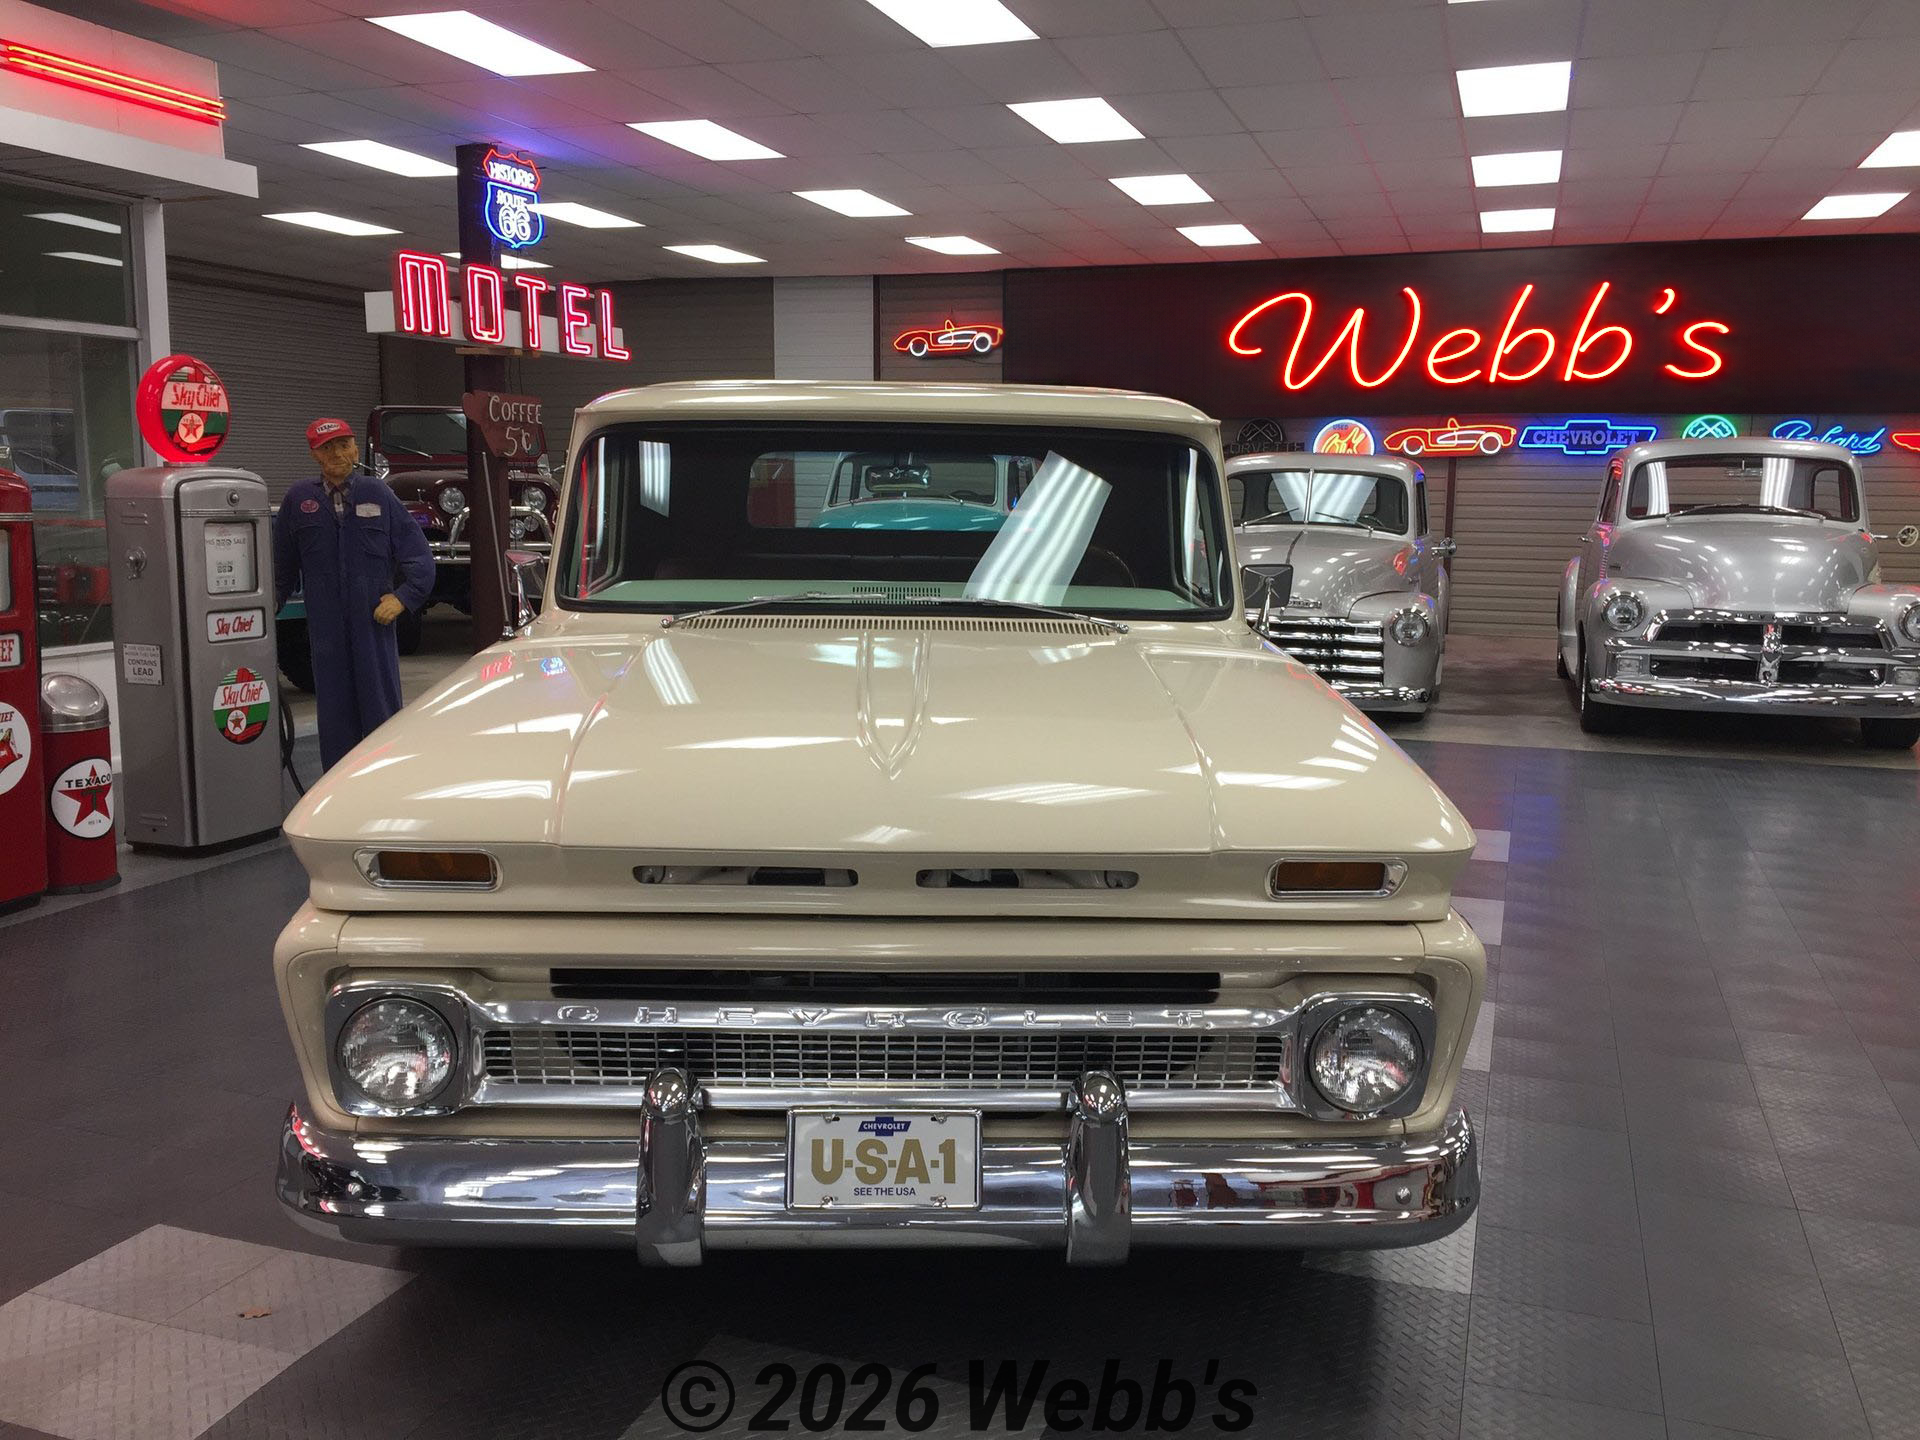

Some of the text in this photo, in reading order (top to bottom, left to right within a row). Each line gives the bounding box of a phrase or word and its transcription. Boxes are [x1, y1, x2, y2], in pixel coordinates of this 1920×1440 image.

[488, 161, 535, 189] HISTORIC
[496, 189, 528, 209] ROUTE
[498, 205, 531, 241] 66
[395, 252, 632, 361] MOTEL
[1228, 281, 1731, 391] Webb's
[171, 383, 223, 409] Sky Chief
[489, 395, 543, 425] COFFEE
[1533, 430, 1640, 446] CHEVROLET
[215, 615, 255, 636] Sky Chief
[132, 667, 154, 676] LEAD
[221, 682, 264, 707] Sky Chief
[65, 773, 111, 788] TEXACO
[556, 1005, 1204, 1029] CHEVROLET
[862, 1122, 906, 1131] CHEVROLET
[853, 1187, 916, 1196] SEE THE USA
